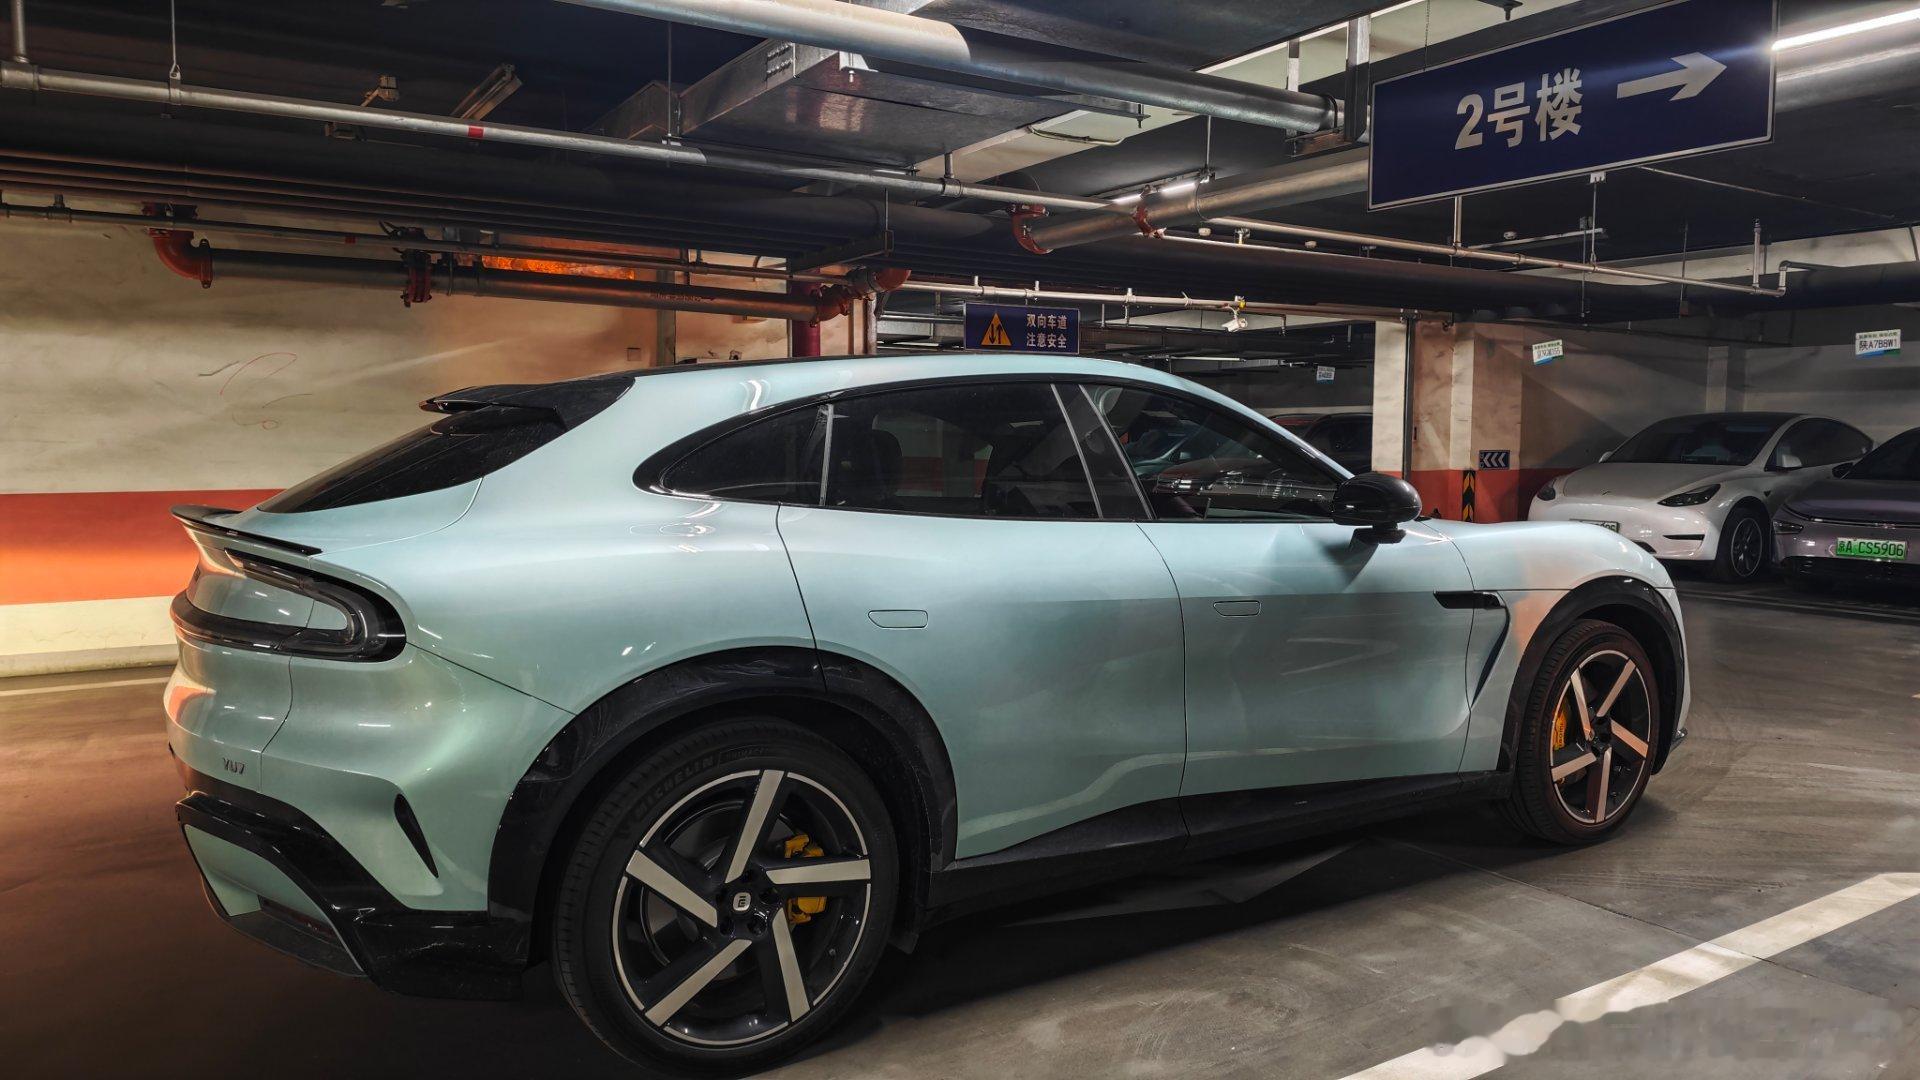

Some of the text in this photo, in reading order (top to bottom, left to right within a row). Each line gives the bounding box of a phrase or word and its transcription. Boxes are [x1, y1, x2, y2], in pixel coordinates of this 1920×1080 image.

[1455, 68, 1583, 150] 2号楼
[1026, 313, 1068, 330] 双向车道
[1026, 332, 1067, 348] 注意安全
[223, 757, 245, 774] YU7
